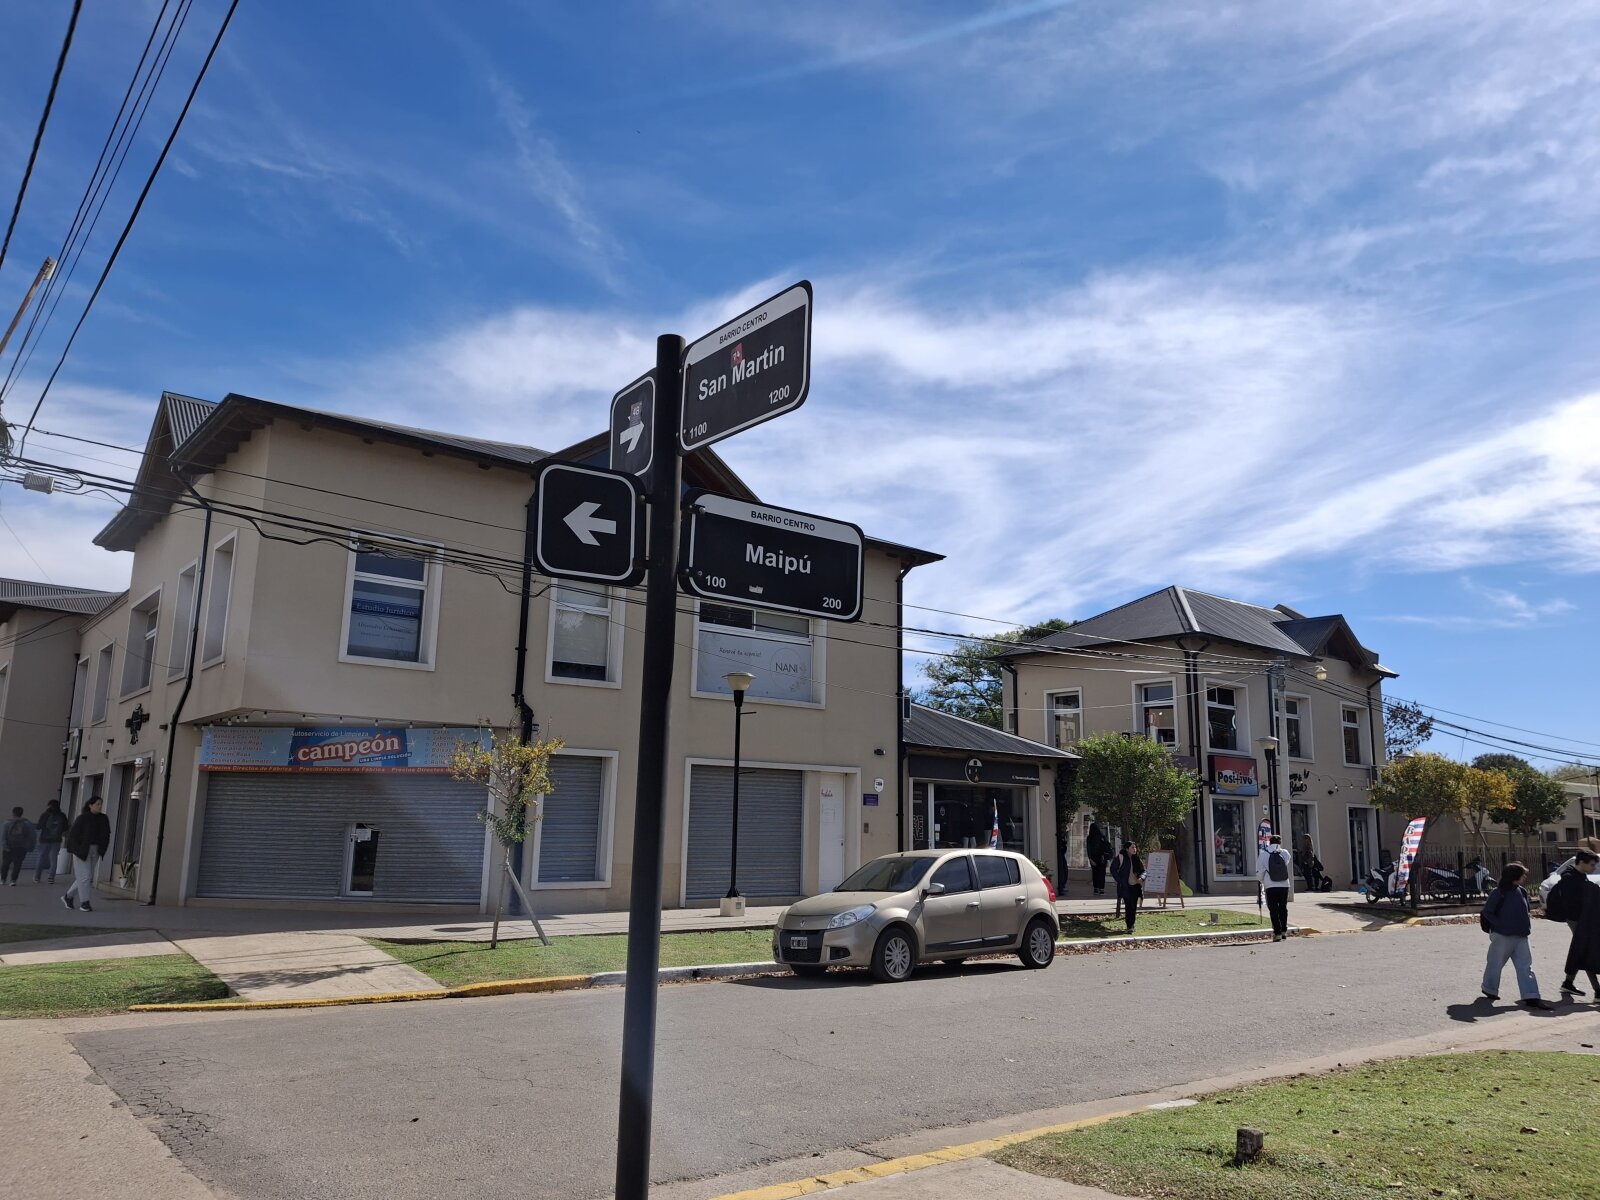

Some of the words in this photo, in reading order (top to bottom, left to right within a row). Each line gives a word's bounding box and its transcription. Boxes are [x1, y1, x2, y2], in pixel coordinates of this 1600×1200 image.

[719, 326, 742, 345] BARRIO
[742, 311, 768, 335] CENTRO
[697, 373, 727, 402] San
[731, 342, 785, 384] Martin
[768, 384, 791, 405] 1200
[689, 421, 708, 440] 1100
[750, 509, 782, 525] BARRIO
[783, 515, 816, 532] CENTRO
[745, 542, 812, 575] Maipú
[705, 574, 727, 589] 100
[822, 596, 843, 611] 200
[775, 662, 798, 674] NANI
[331, 729, 339, 738] de
[340, 729, 370, 739] Limpieza
[297, 732, 400, 762] campeón
[1217, 771, 1254, 785] Positivo
